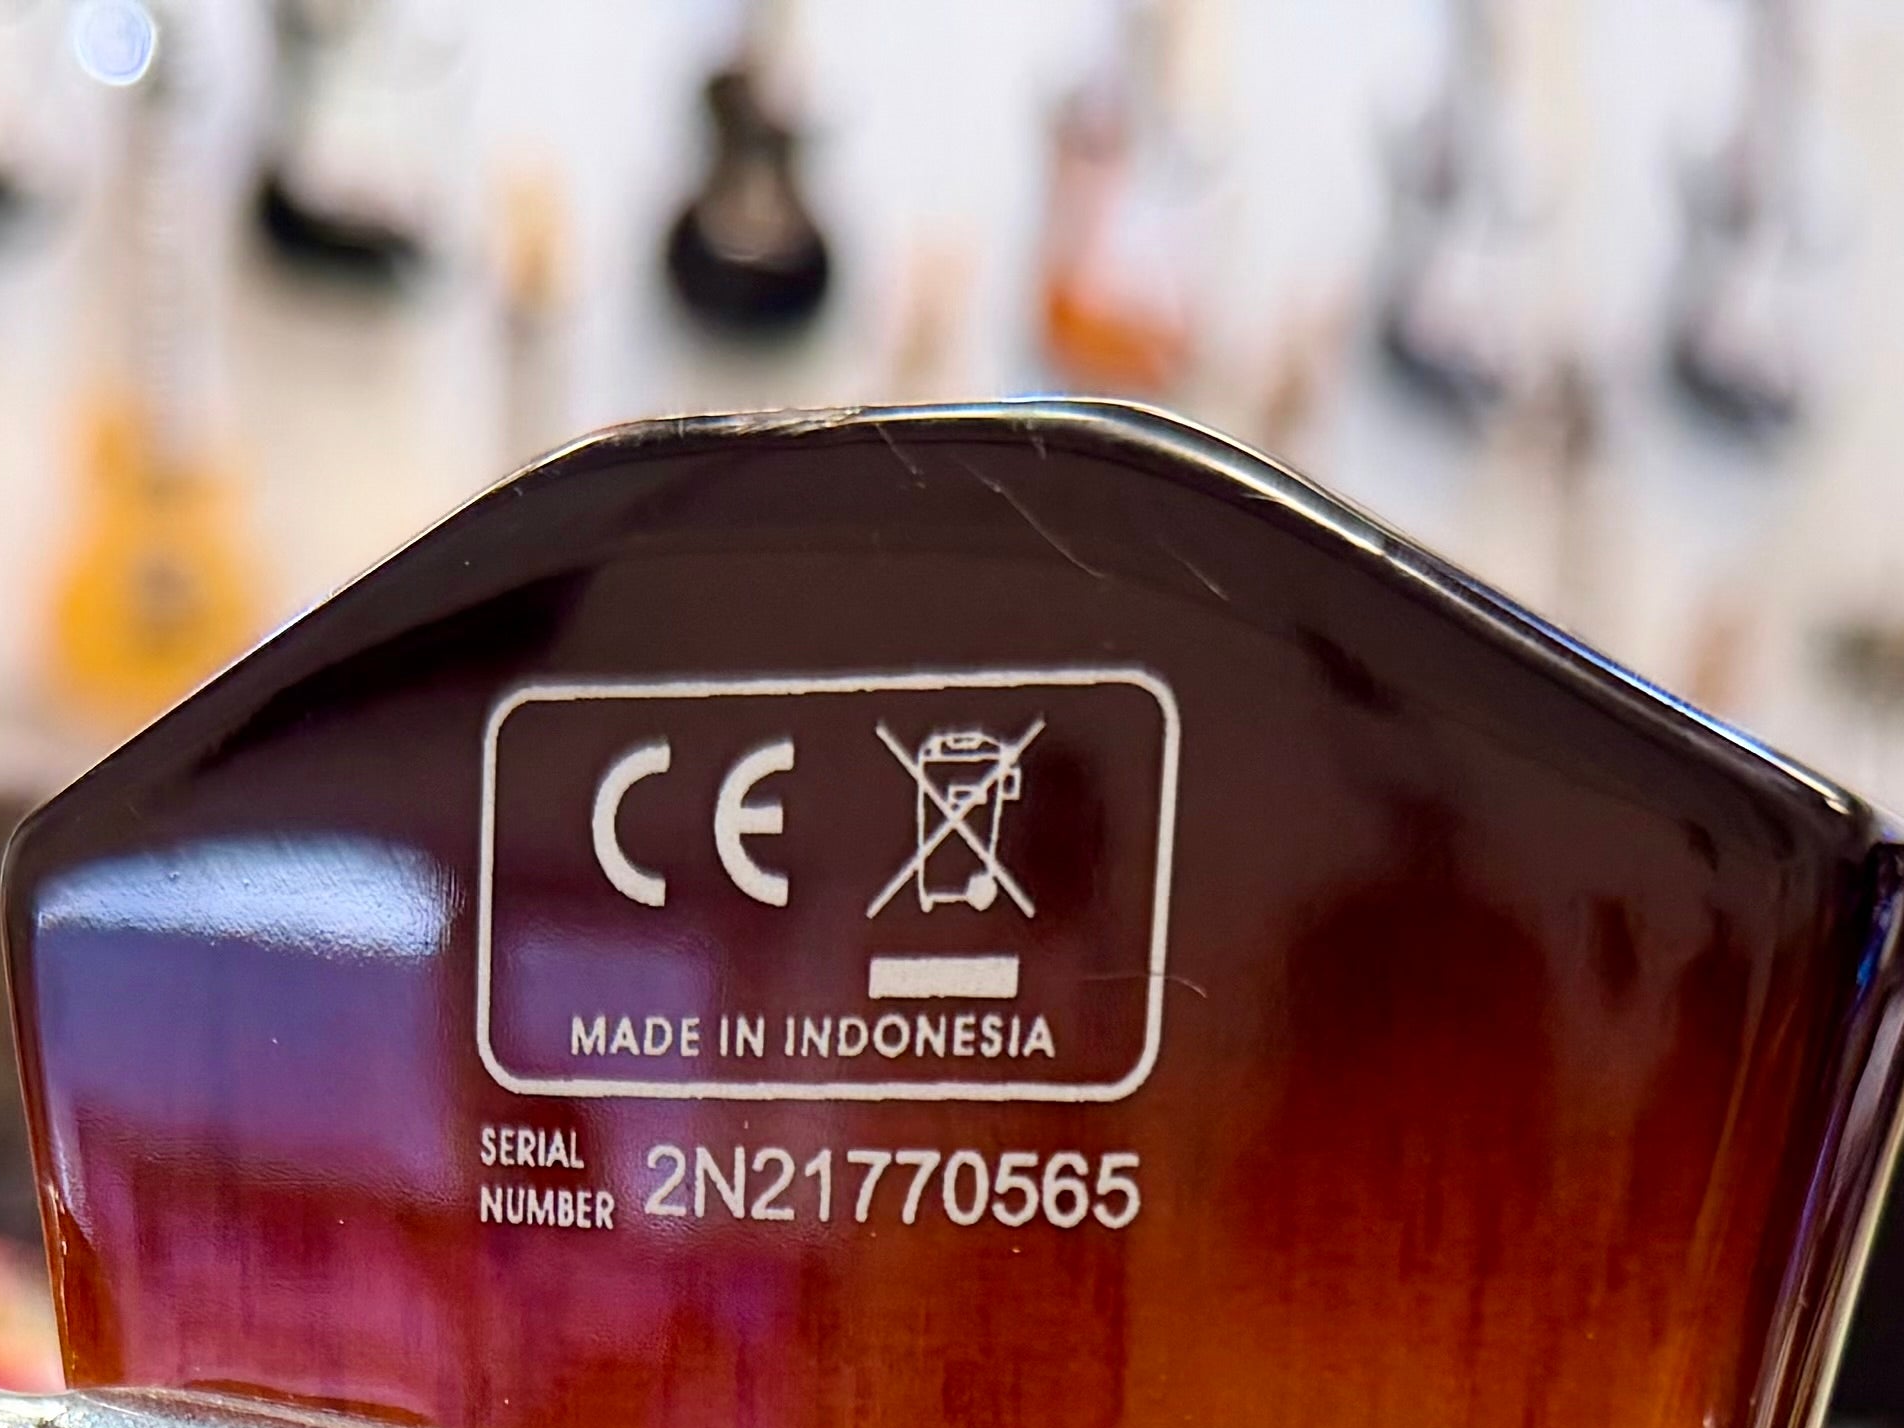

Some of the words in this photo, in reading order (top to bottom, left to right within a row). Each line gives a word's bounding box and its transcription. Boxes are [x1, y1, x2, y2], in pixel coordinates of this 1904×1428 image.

[591, 738, 796, 908] CE
[569, 1015, 701, 1058] MADE
[719, 1016, 765, 1058] IN
[783, 1014, 1056, 1059] INDONESIA
[479, 1126, 585, 1169] SERIAL
[479, 1185, 616, 1230] NUMBER
[643, 1144, 1141, 1229] 2N21770565
